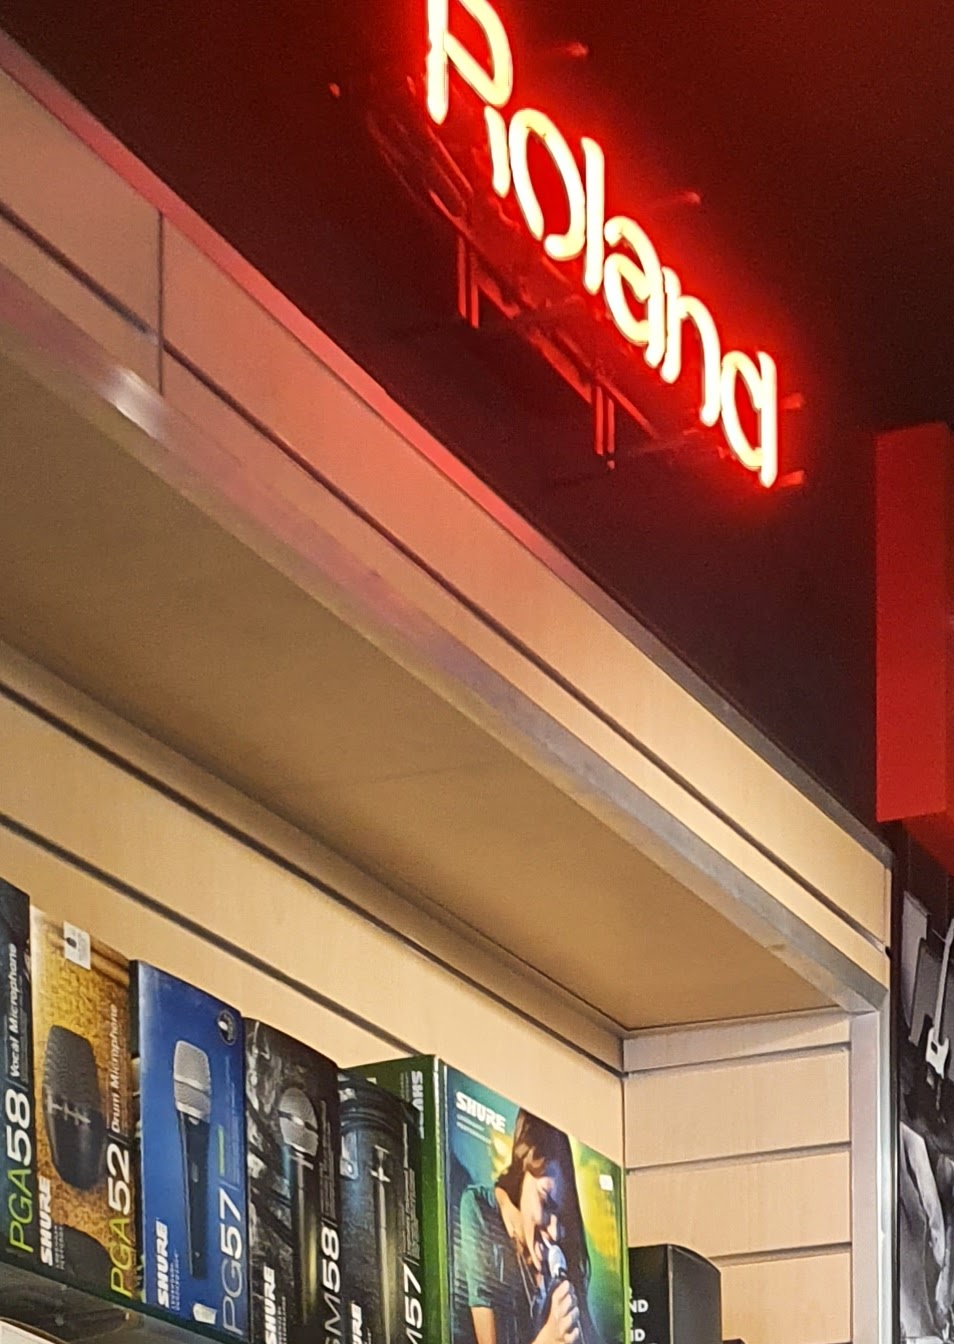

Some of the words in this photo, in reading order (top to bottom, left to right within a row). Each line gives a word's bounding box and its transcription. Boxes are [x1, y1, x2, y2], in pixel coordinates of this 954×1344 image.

[424, 0, 780, 488] Roland
[8, 943, 19, 1034] Microphone
[9, 1036, 20, 1078] Vocal
[108, 1003, 118, 1099] Microphone
[111, 1101, 120, 1134] Drum
[456, 1089, 506, 1134] SHURE
[7, 1088, 34, 1254] PGA58
[39, 1175, 54, 1268] SHURE
[107, 1143, 133, 1298] PGA52
[156, 1220, 169, 1309] SHURE
[219, 1187, 244, 1336] PG57
